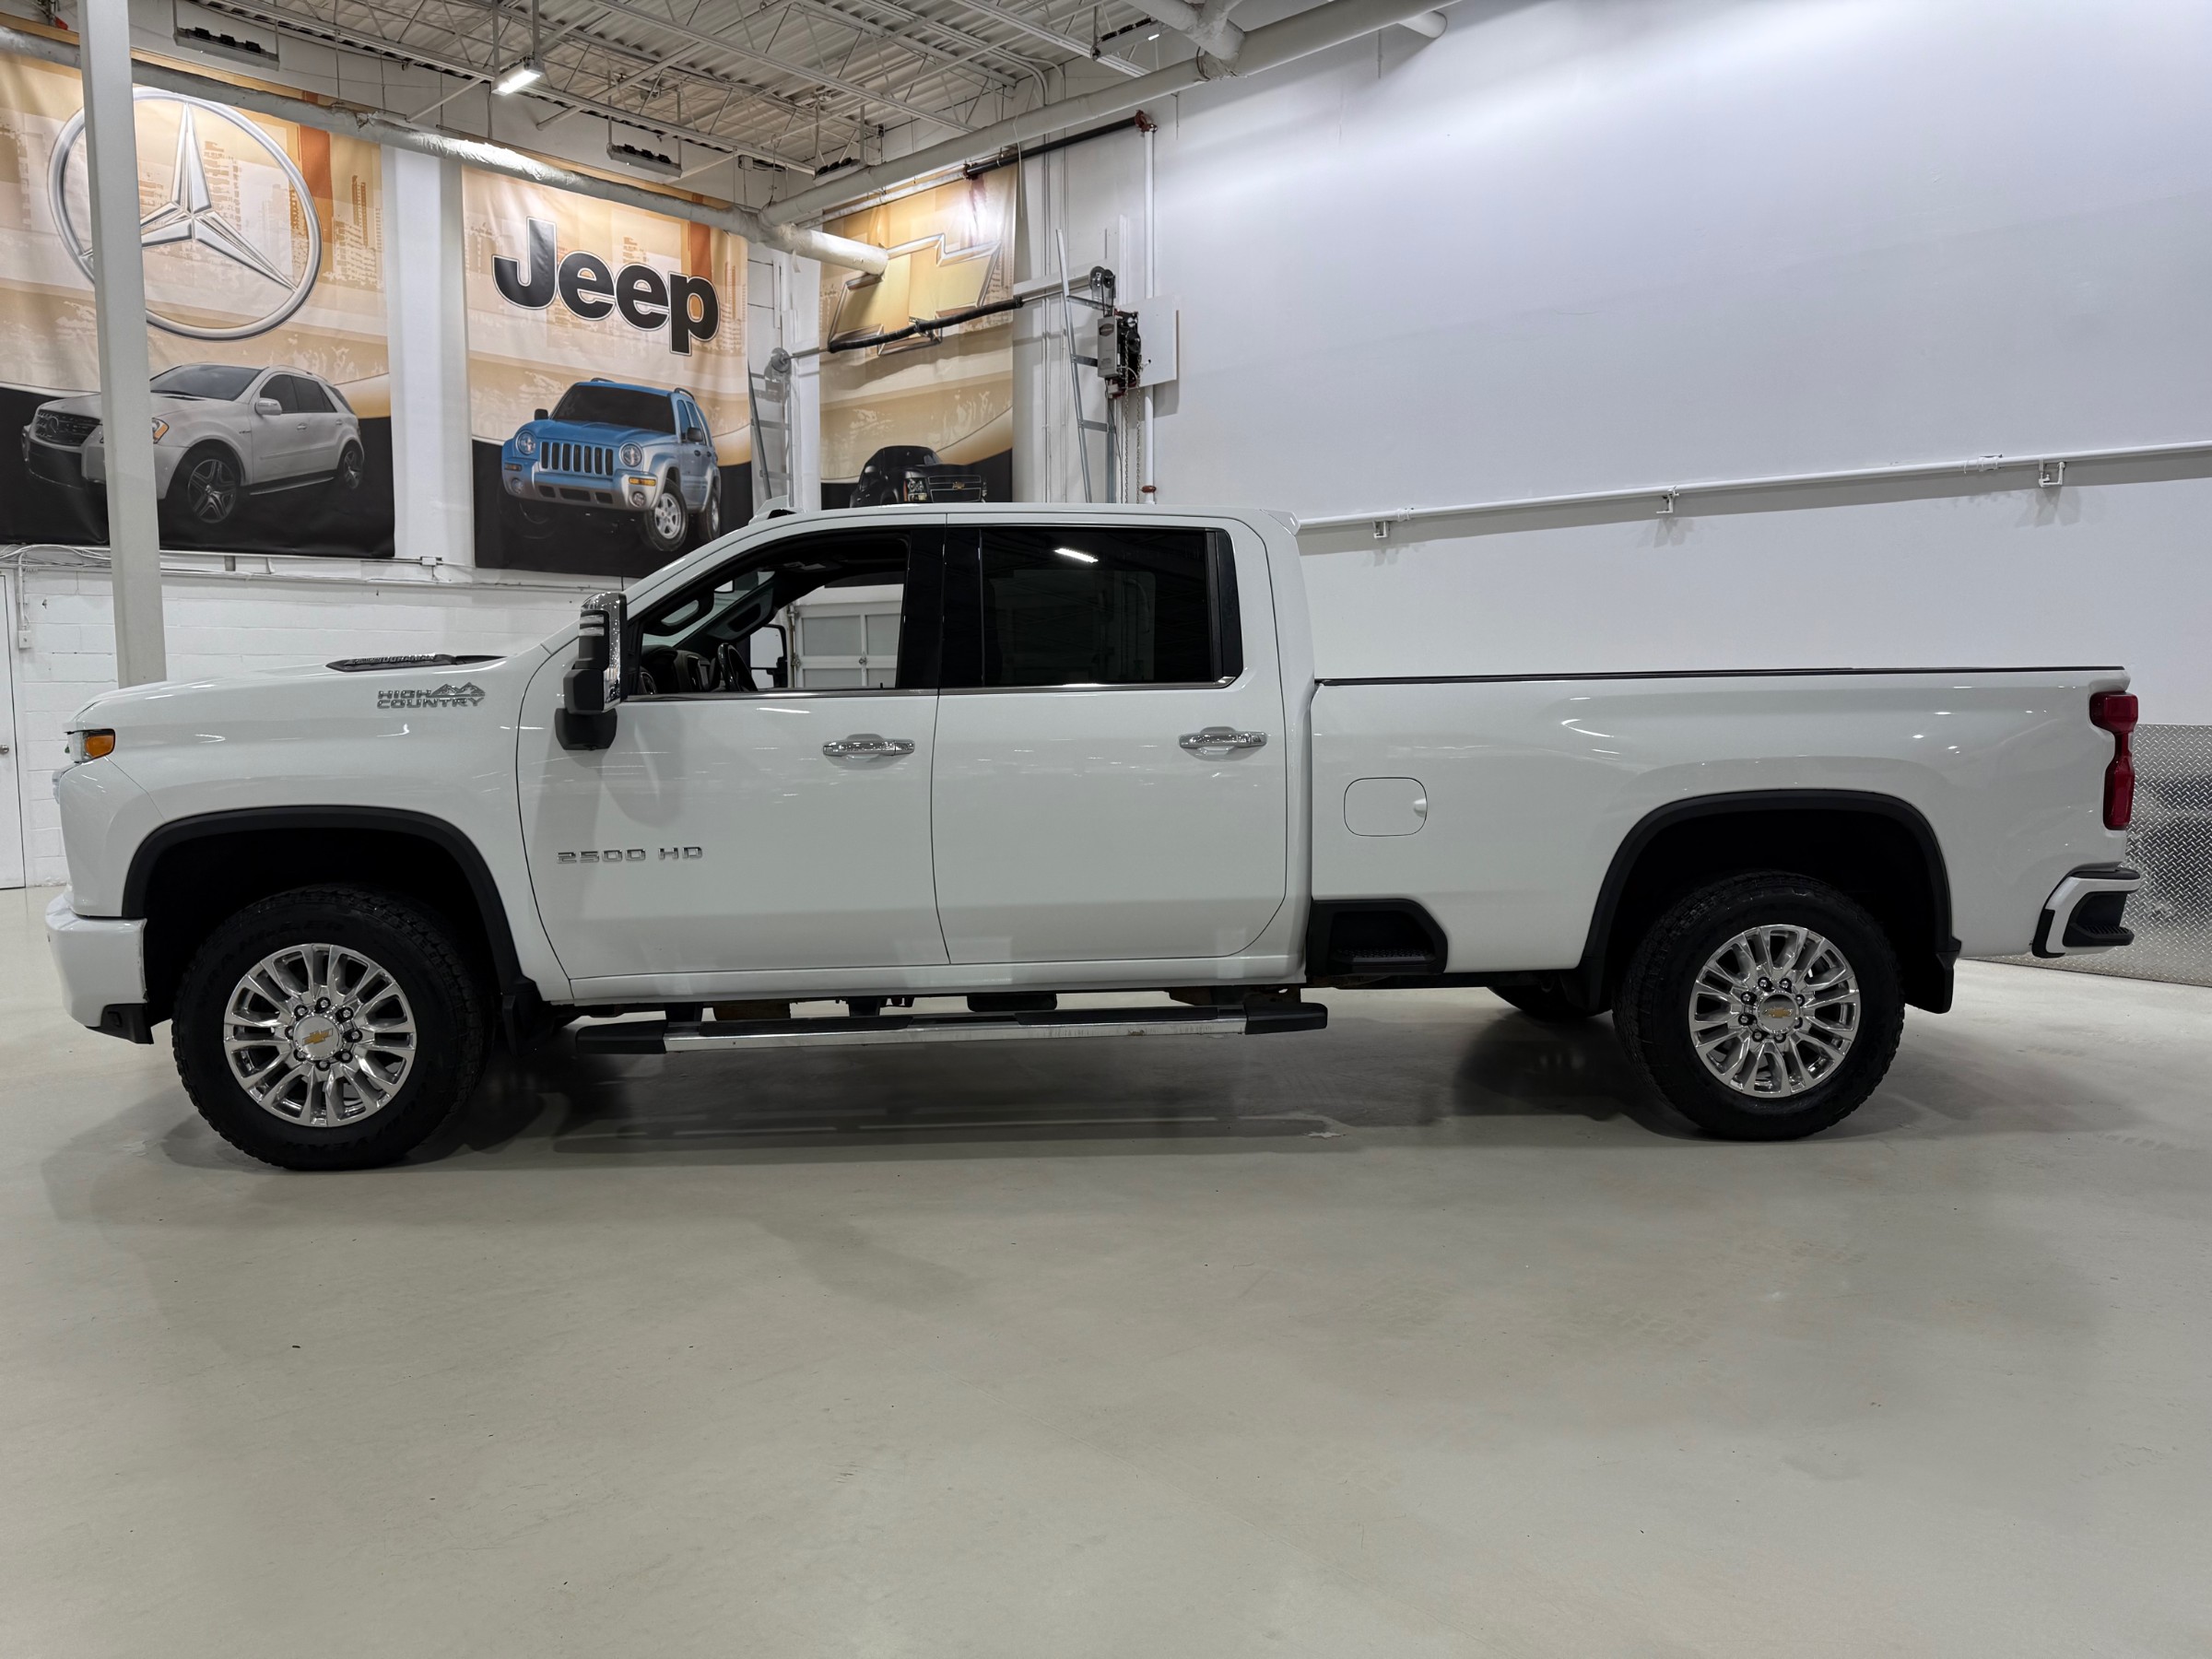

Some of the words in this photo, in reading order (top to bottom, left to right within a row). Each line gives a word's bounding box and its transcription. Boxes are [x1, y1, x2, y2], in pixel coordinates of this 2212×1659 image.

[491, 217, 721, 356] Jeep
[378, 689, 432, 700] HIGH
[377, 698, 485, 709] COUNTRY
[557, 849, 646, 864] 2500
[658, 846, 703, 860] HD
